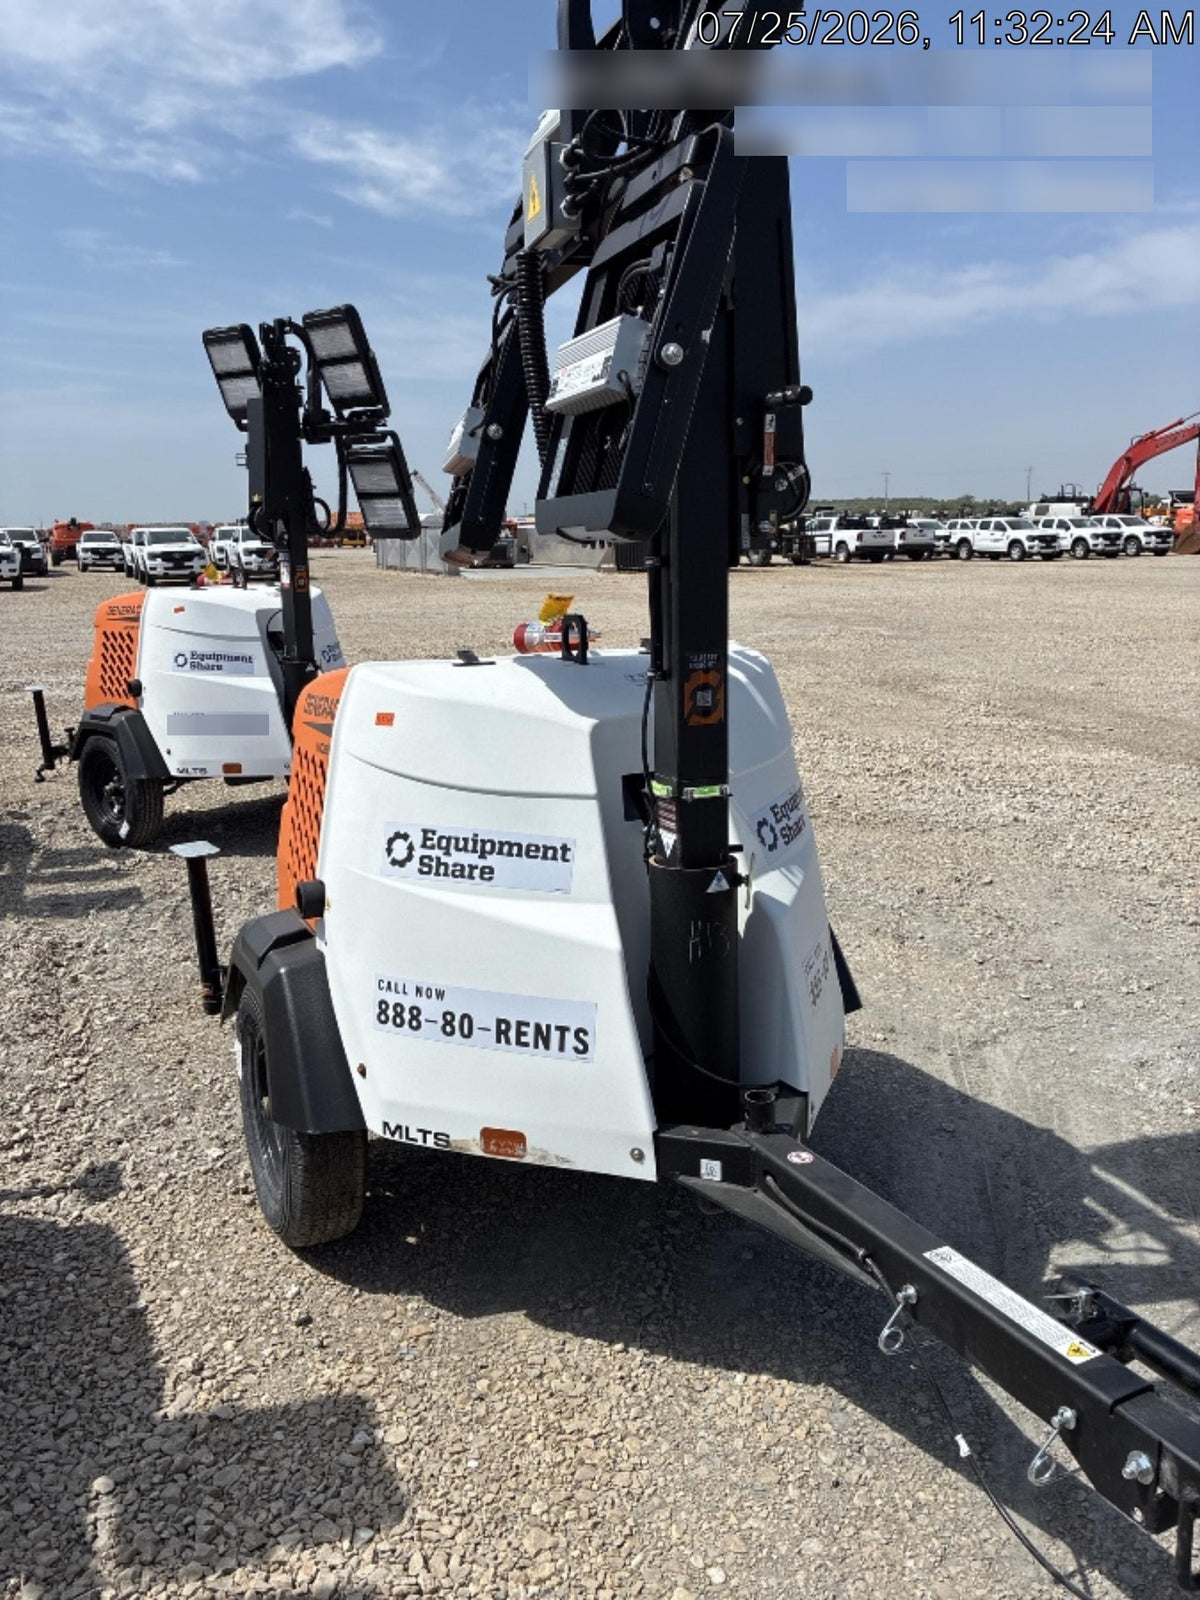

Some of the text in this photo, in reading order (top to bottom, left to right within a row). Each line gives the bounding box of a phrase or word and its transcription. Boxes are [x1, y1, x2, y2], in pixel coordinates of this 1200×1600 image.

[189, 661, 223, 671] Share
[190, 650, 254, 664] Equipment
[420, 828, 572, 862] Equipment
[417, 855, 495, 882] Share
[378, 979, 446, 1001] CALL NOW
[376, 999, 589, 1055] 888-80-RENTS
[382, 1120, 451, 1149] MLTS
